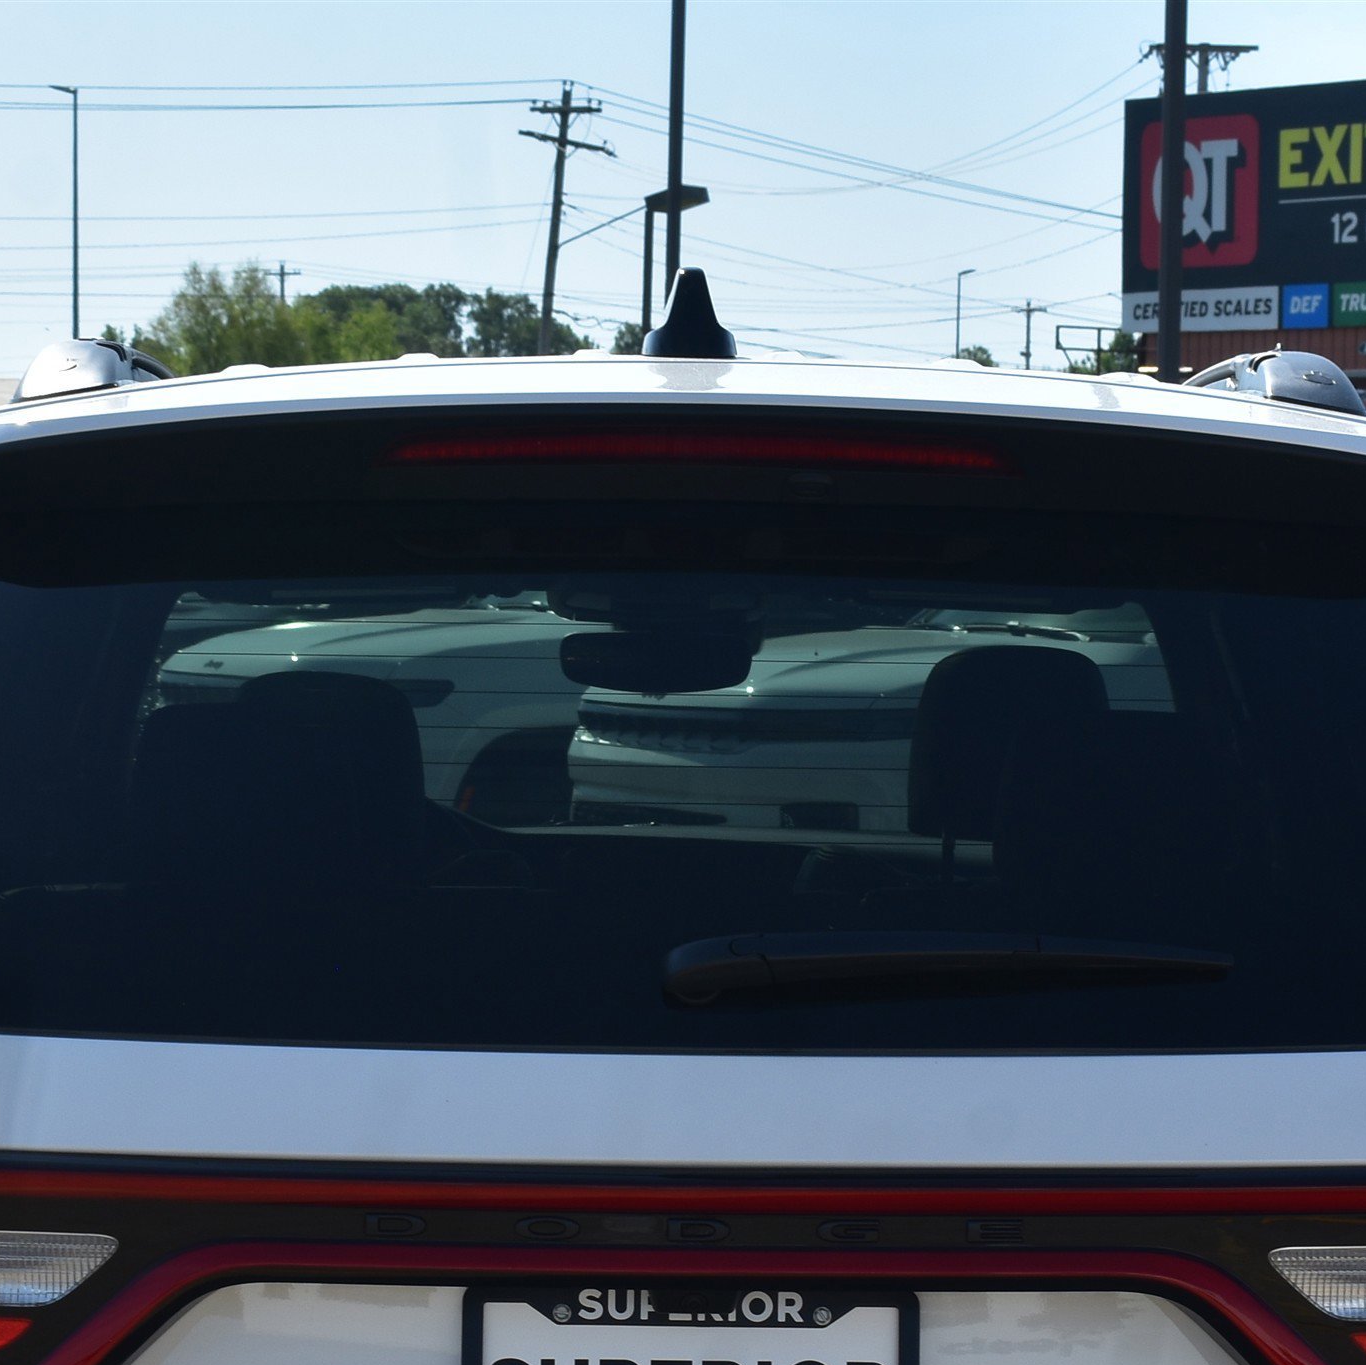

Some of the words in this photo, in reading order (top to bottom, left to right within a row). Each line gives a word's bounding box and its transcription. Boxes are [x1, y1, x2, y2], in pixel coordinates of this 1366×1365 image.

[1331, 211, 1358, 244] 12
[1213, 298, 1272, 317] SCALES
[1290, 295, 1321, 314] DEF
[362, 1211, 1026, 1245] DODGE
